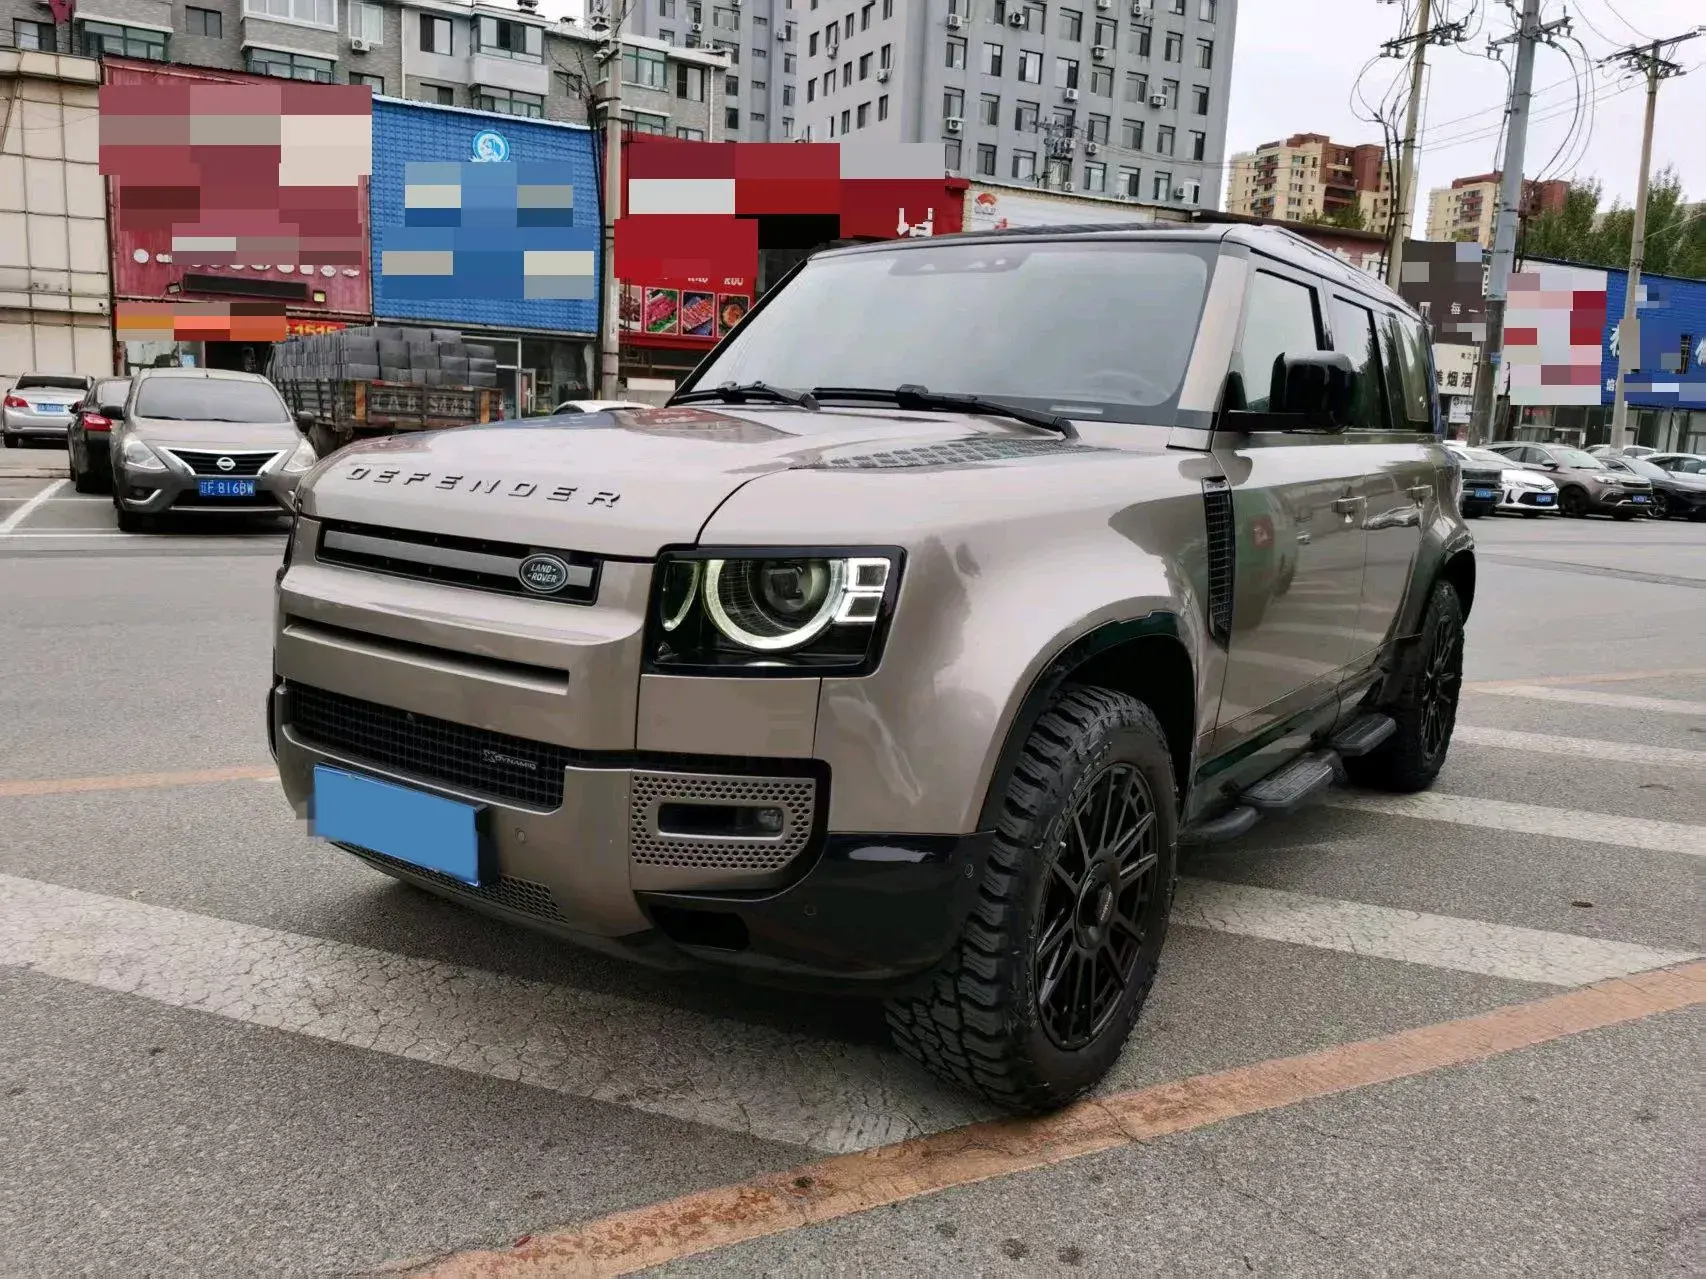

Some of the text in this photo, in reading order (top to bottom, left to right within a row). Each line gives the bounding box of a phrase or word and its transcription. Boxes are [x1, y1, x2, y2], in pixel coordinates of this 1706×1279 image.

[346, 468, 620, 507] DEFENDER
[530, 563, 552, 573] LAND
[531, 572, 557, 583] ROVER
